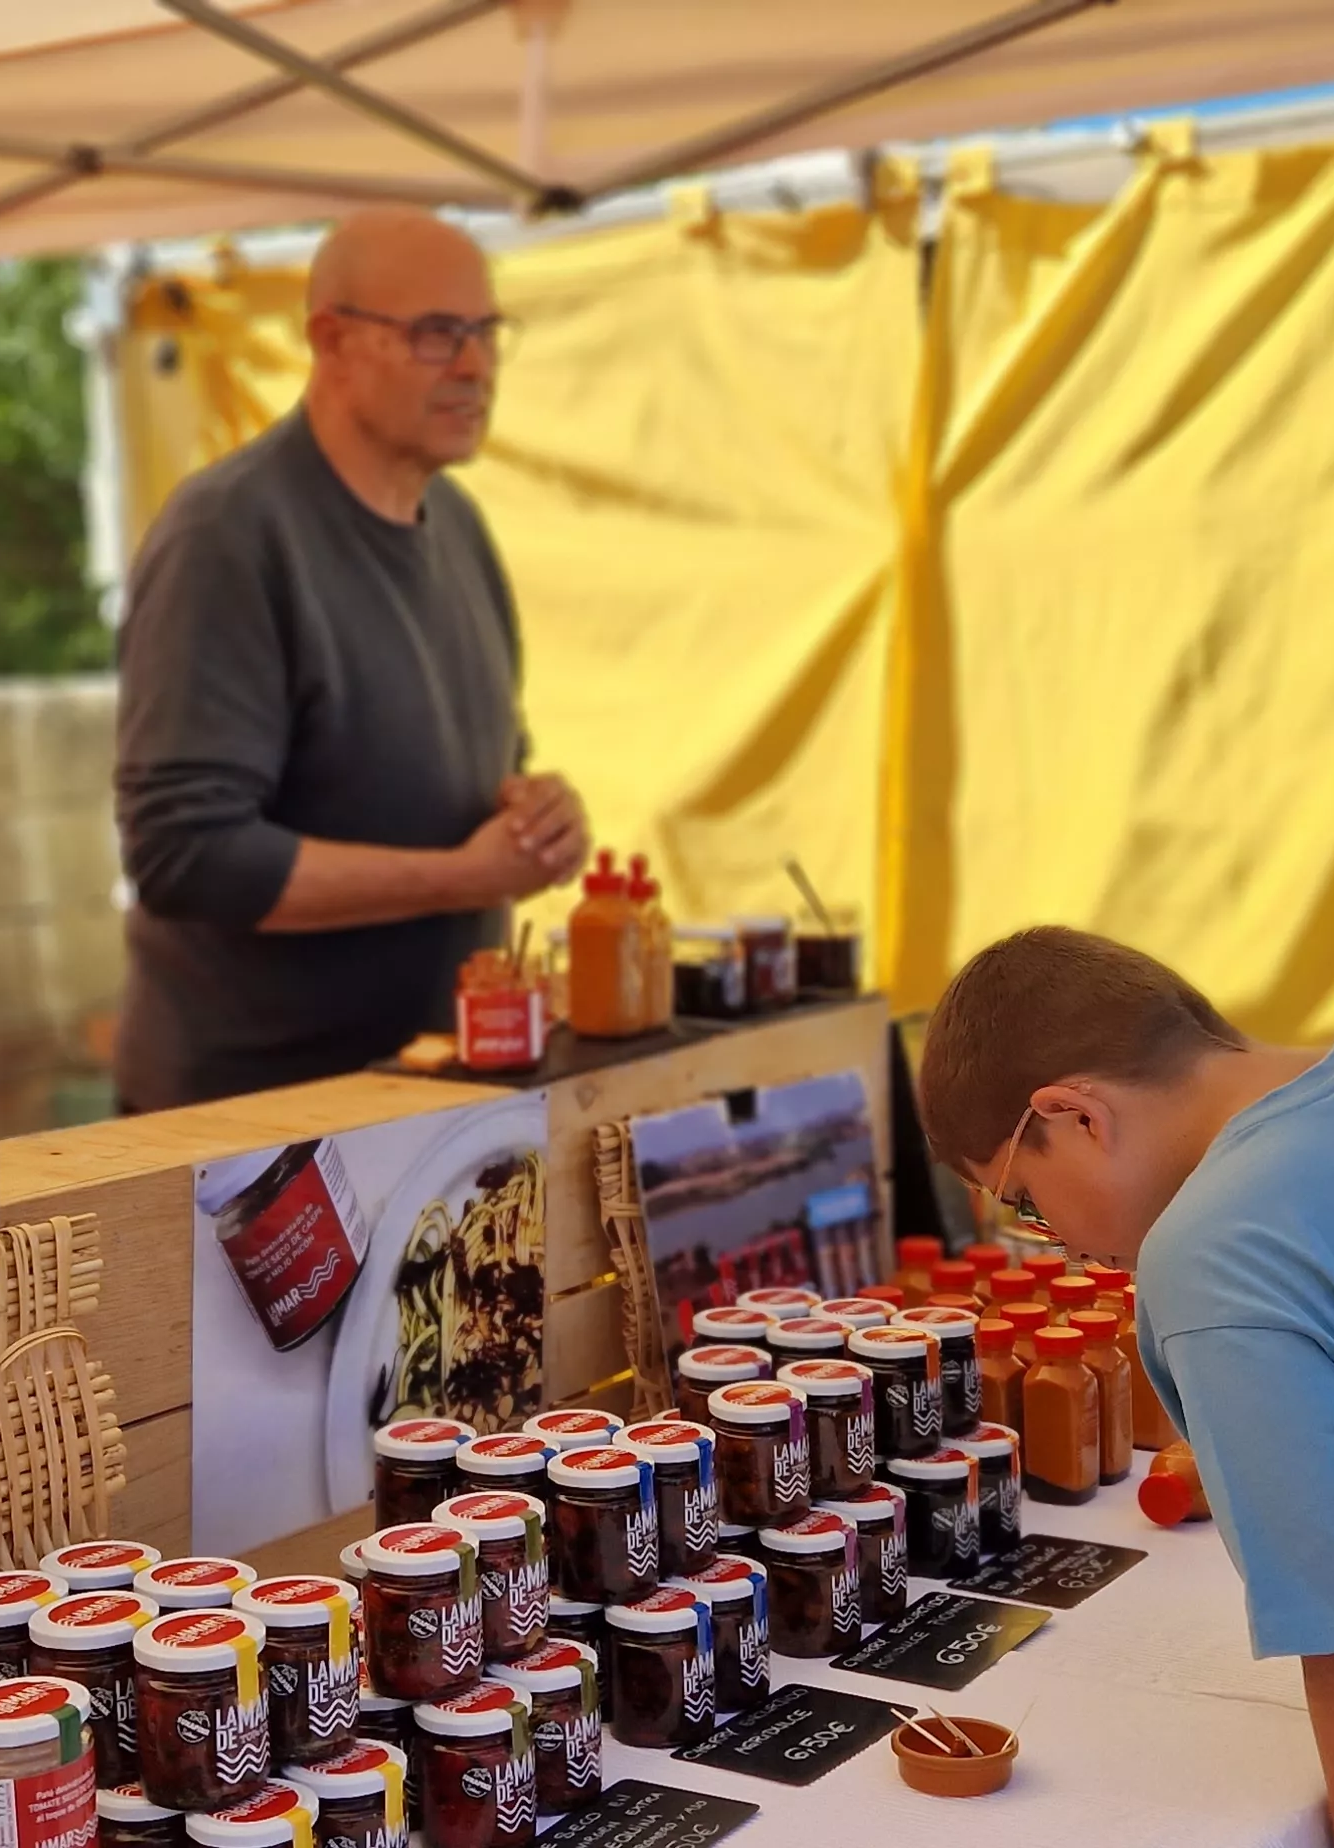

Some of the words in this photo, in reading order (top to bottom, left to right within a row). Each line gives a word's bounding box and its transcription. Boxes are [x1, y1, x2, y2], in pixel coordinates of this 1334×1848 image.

[774, 1460, 790, 1477] DE
[685, 1506, 701, 1525] DE
[627, 1529, 643, 1551] DE
[509, 1586, 527, 1607] DE
[442, 1623, 460, 1646] DE
[740, 1641, 756, 1662] DE
[308, 1681, 329, 1705] DE
[684, 1675, 700, 1696] DE
[216, 1727, 238, 1752] DE
[567, 1738, 584, 1760] DE
[682, 1728, 739, 1760] CHERRY
[784, 1720, 857, 1760] 6,50€
[496, 1782, 515, 1805] DE
[625, 1792, 664, 1817] EXTRA
